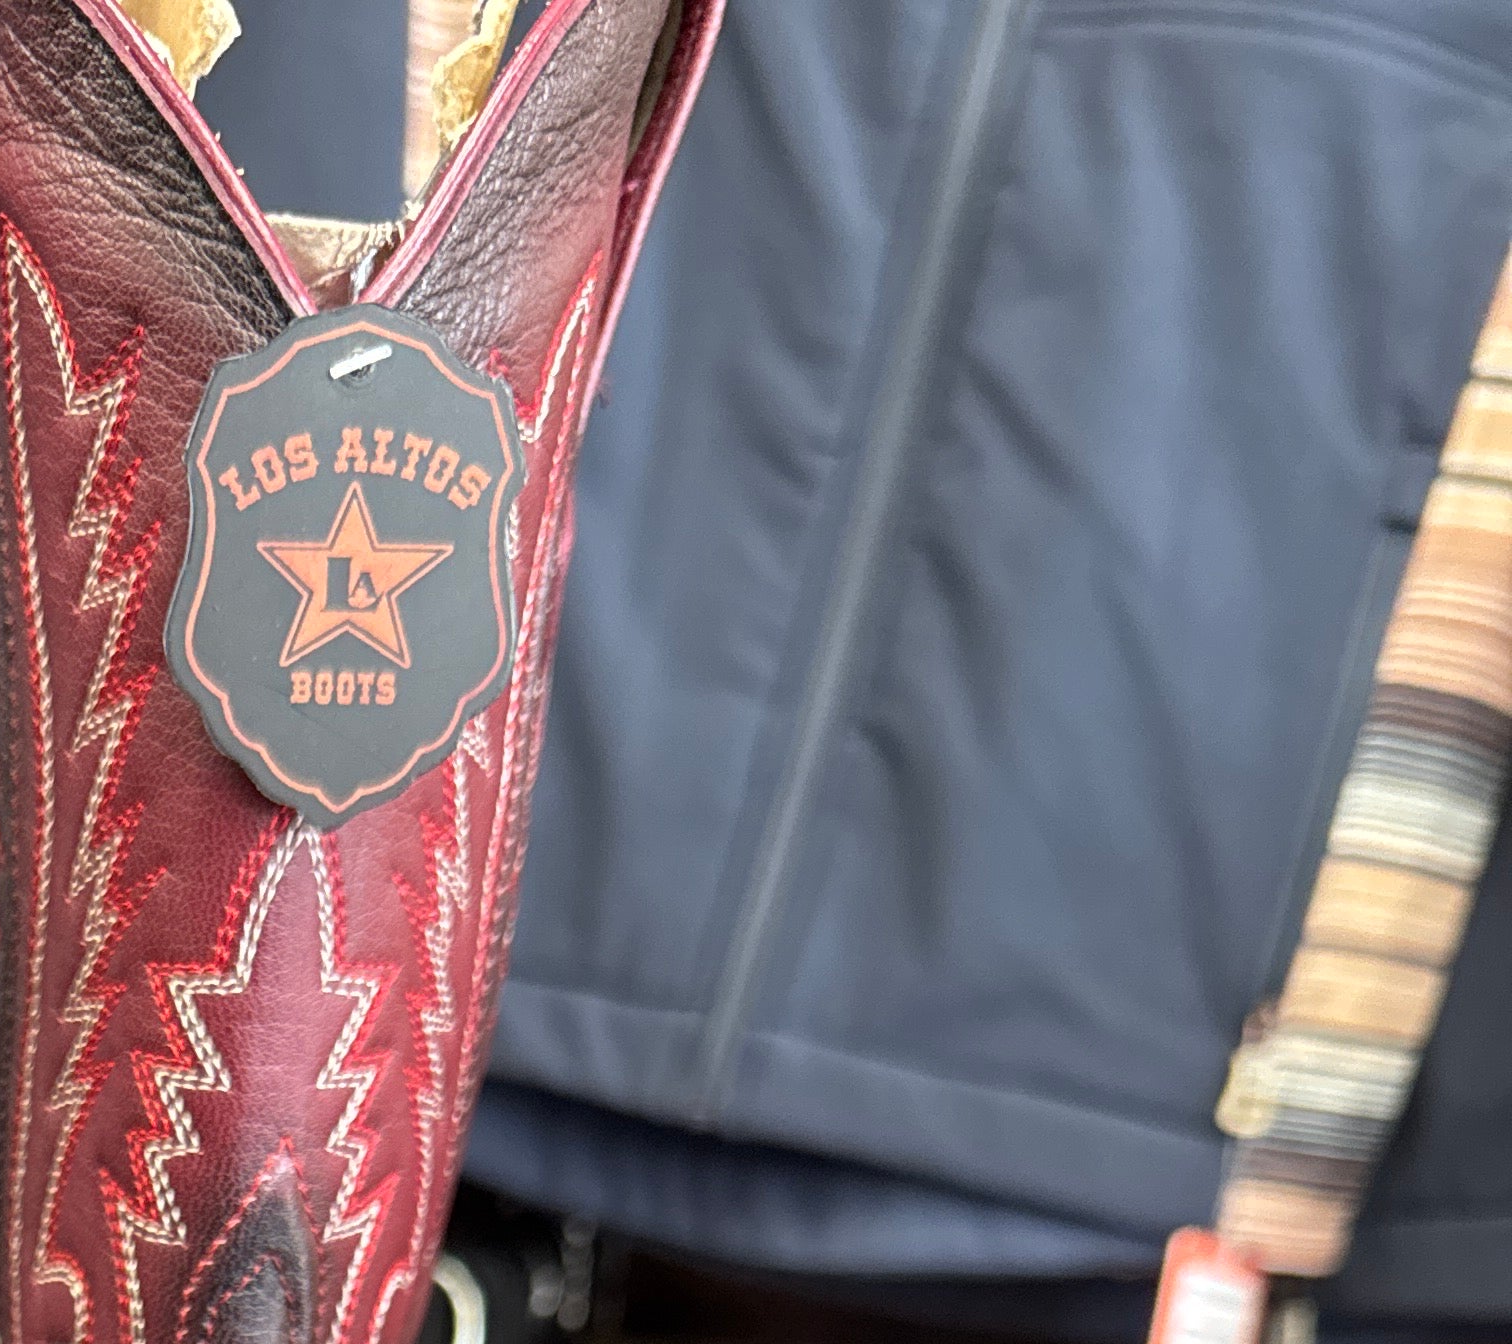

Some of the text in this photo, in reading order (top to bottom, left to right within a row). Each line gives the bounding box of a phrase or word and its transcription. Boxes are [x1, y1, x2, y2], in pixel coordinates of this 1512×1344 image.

[218, 426, 492, 511] LOS ALTOS
[320, 556, 385, 613] LA
[289, 670, 397, 707] BOOTS
